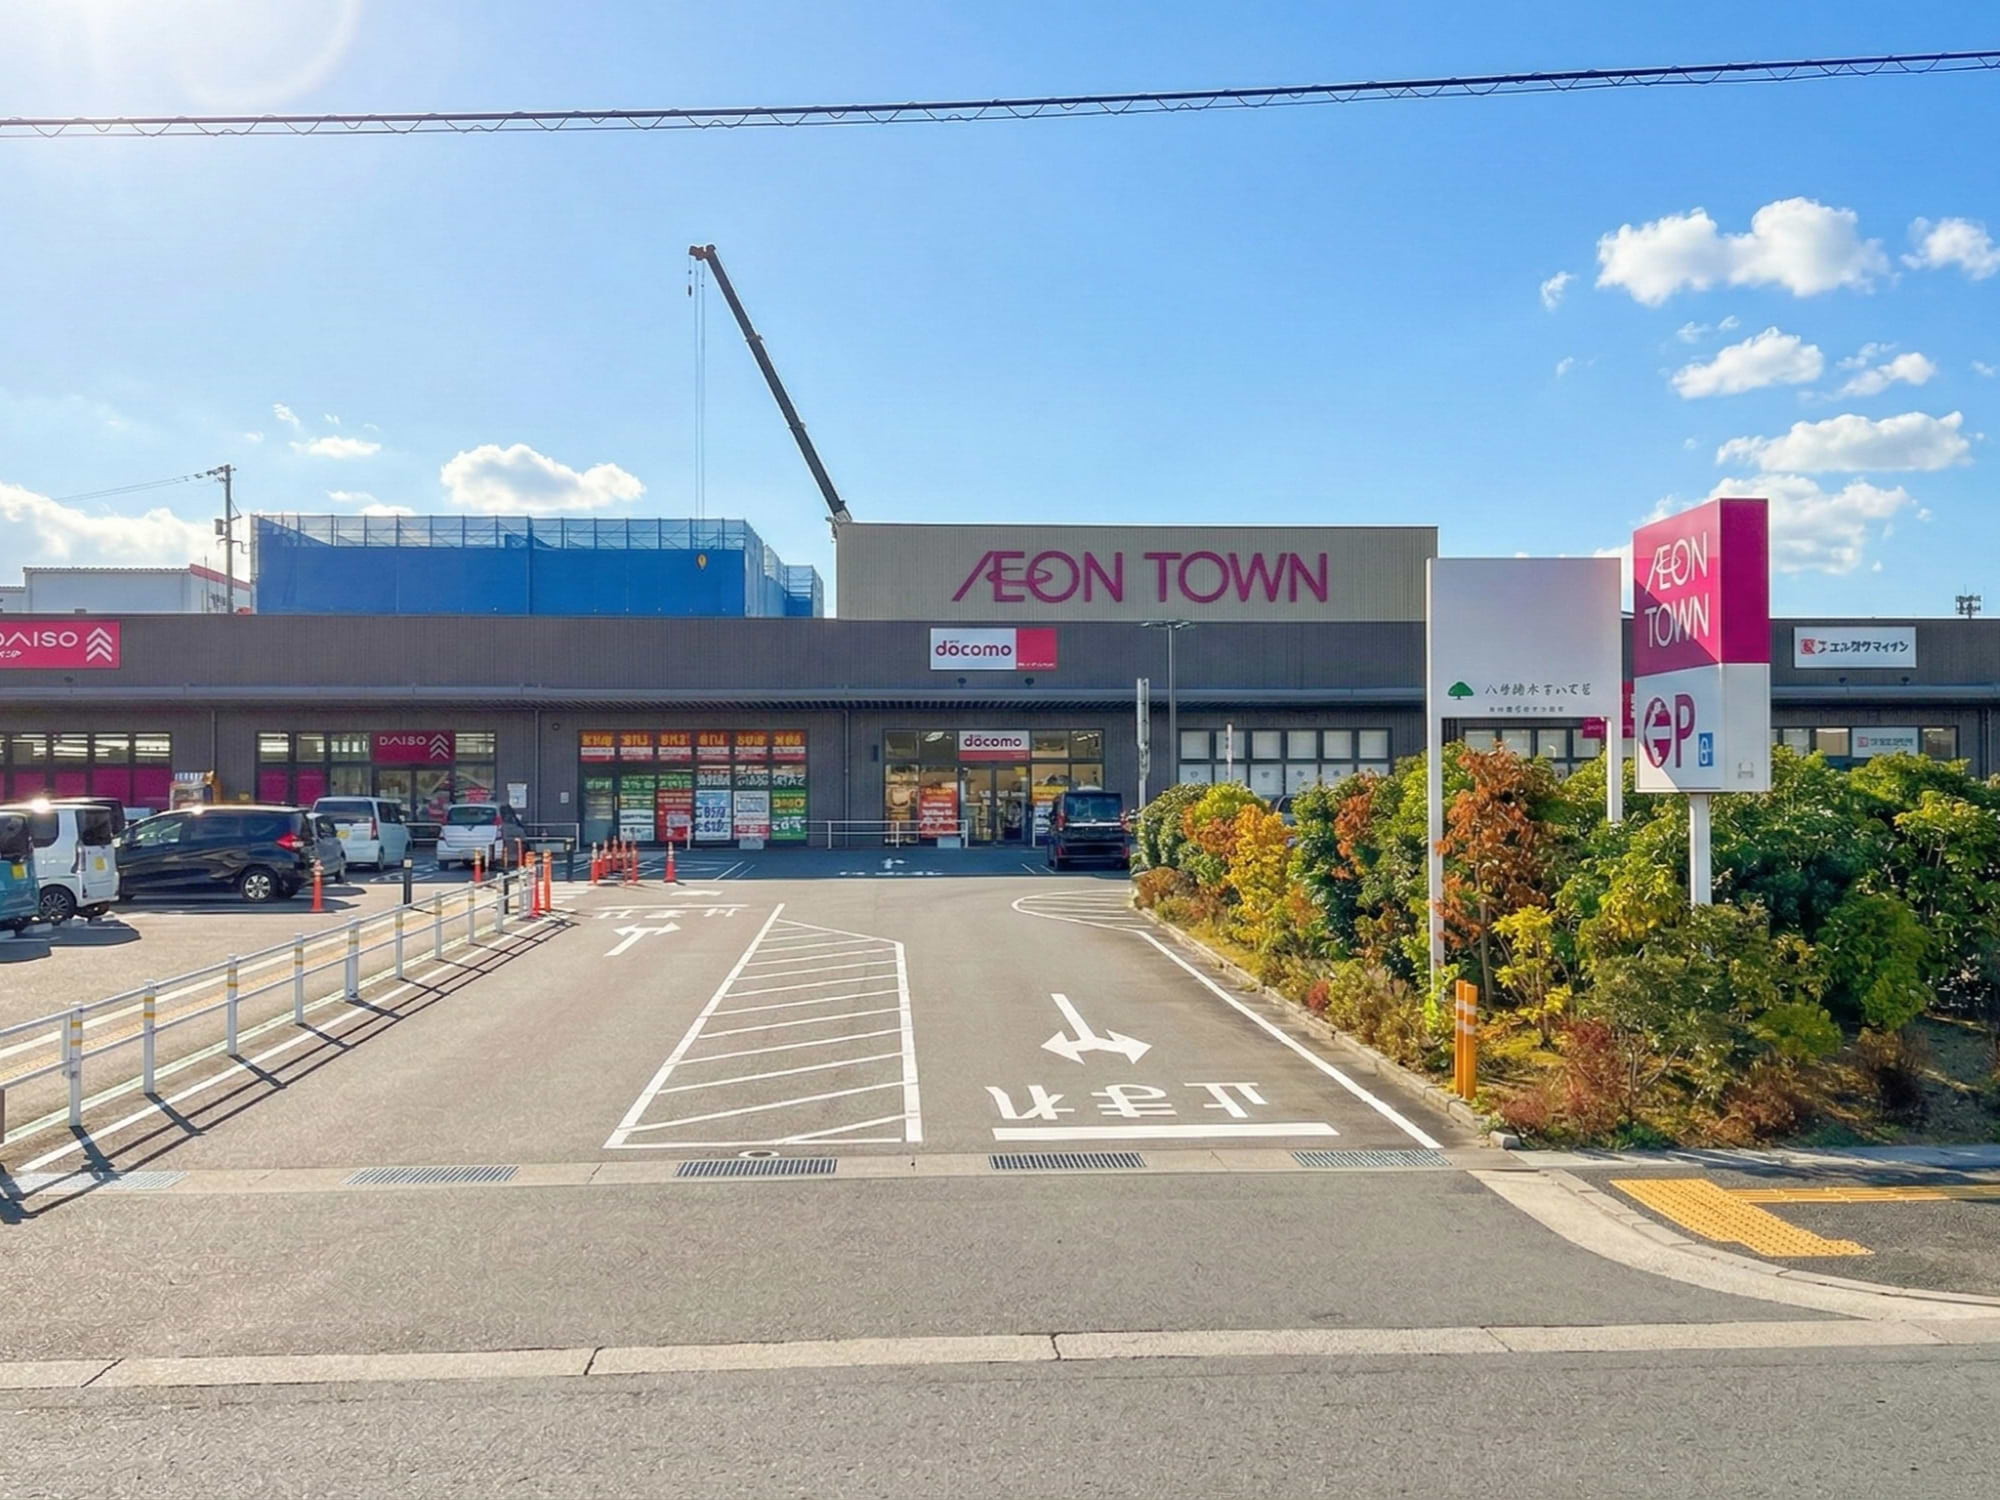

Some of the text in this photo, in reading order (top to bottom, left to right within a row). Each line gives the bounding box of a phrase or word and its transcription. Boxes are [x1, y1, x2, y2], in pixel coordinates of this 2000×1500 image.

[1144, 551, 1328, 603] TOWN
[1644, 593, 1710, 649] TOWN
[935, 640, 1012, 657] docomo
[379, 735, 427, 746] DAISO
[964, 734, 1022, 747] docomo
[985, 1082, 1268, 1120] 止まれ
